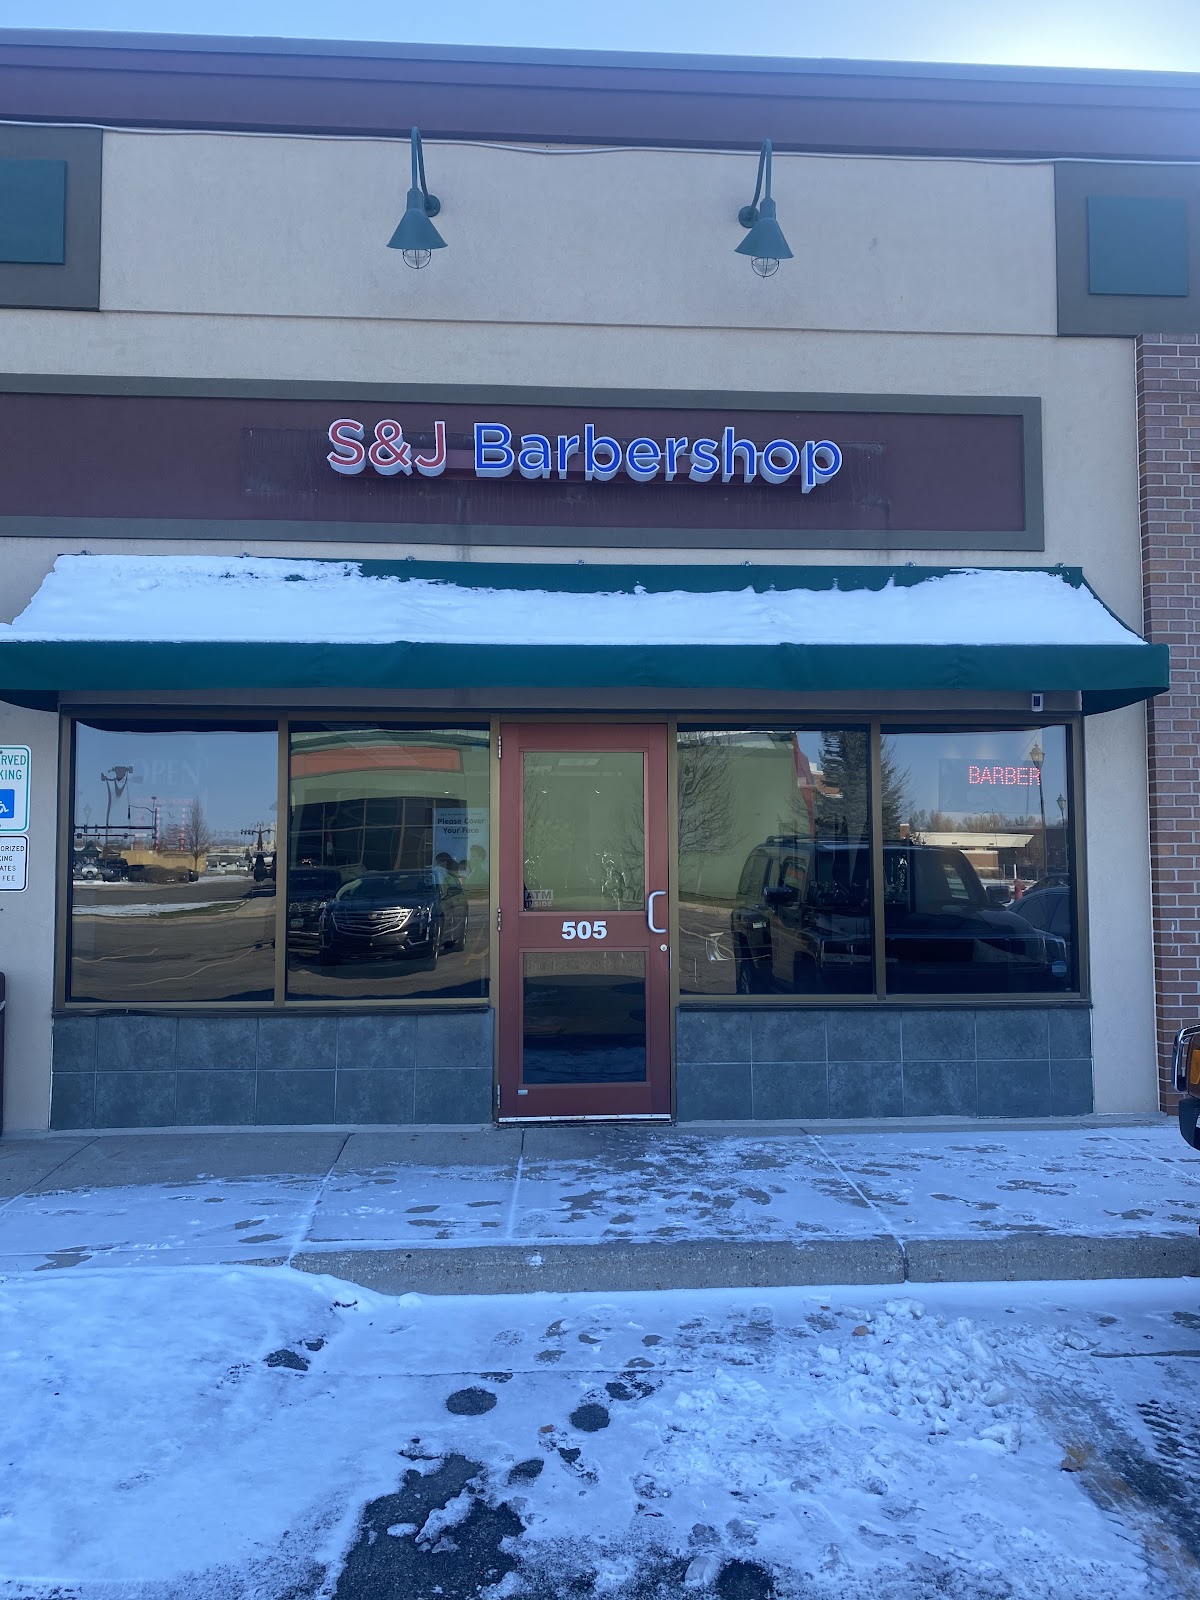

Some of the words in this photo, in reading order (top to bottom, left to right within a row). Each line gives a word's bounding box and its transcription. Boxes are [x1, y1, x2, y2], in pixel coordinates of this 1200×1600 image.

[326, 418, 447, 477] S&J
[473, 421, 843, 493] Barbershop
[969, 765, 1041, 786] BARBER
[464, 817, 485, 825] Cover
[2, 874, 16, 882] FEE
[526, 890, 553, 900] ATM
[526, 900, 553, 908] INSIDE
[561, 920, 608, 940] 505
